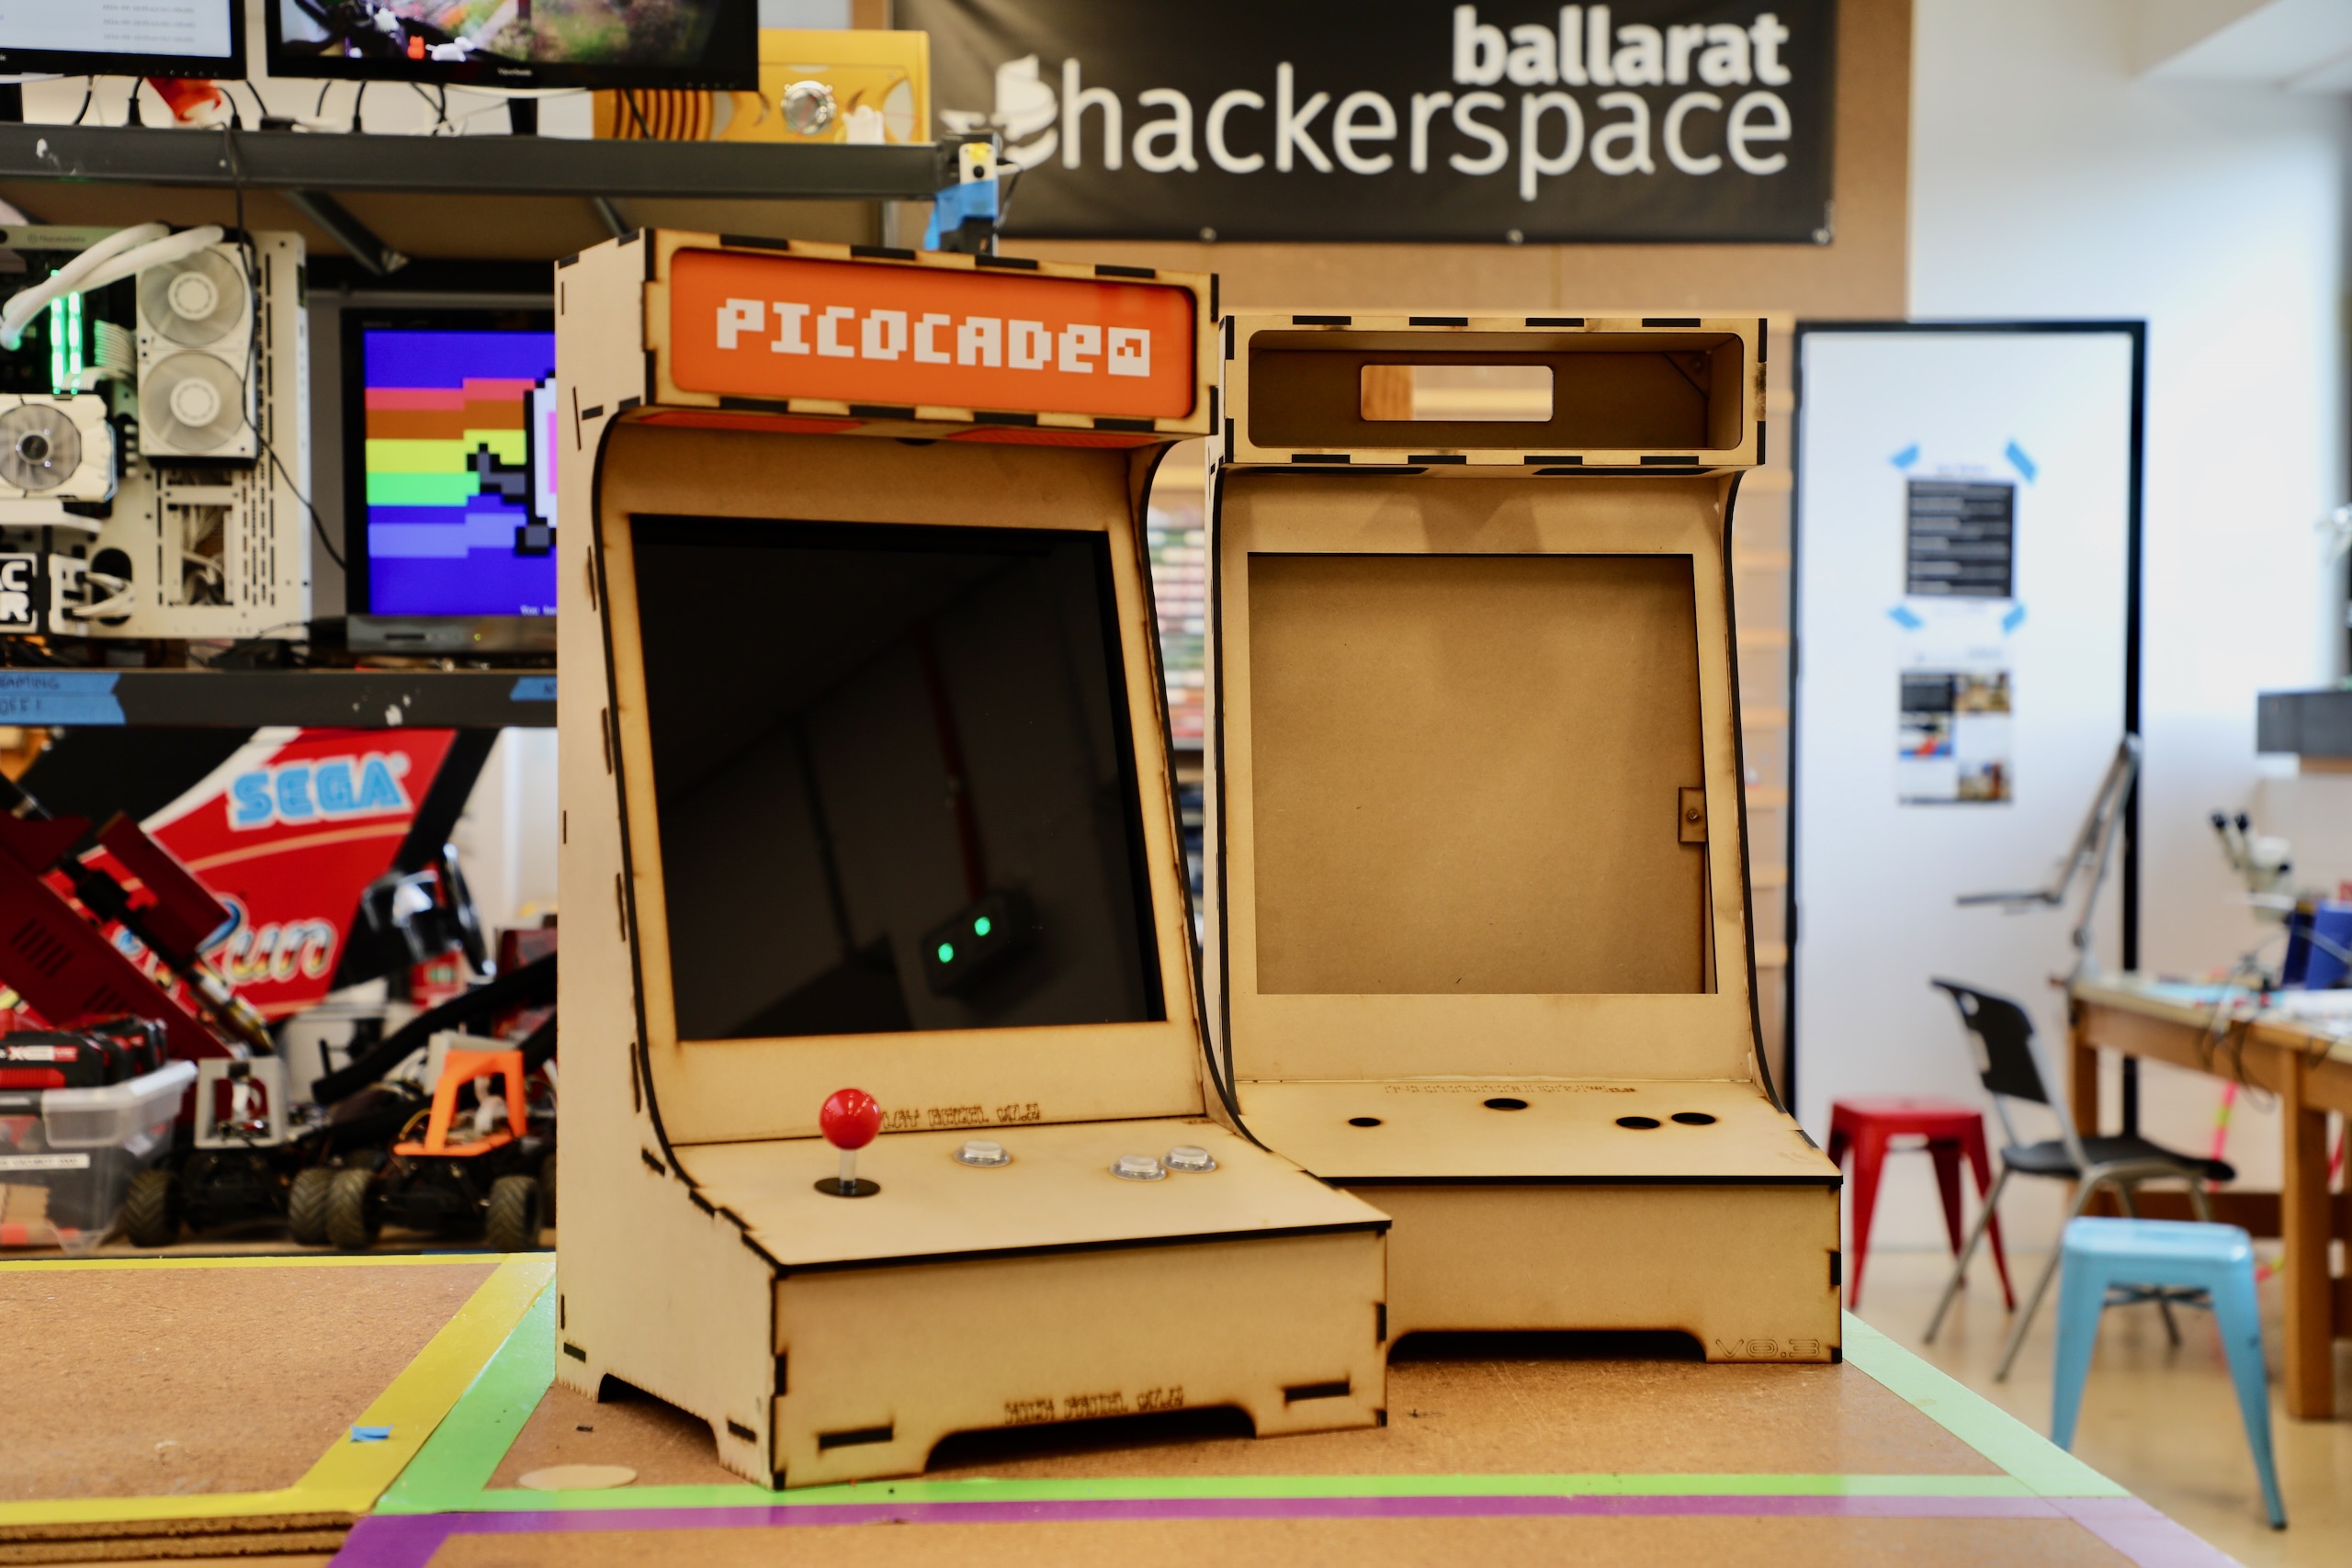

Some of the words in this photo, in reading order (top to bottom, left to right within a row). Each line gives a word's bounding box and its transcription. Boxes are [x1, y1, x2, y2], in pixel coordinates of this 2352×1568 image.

[1453, 5, 1790, 85] ballarat
[1061, 59, 1791, 200] hackerspace
[232, 756, 408, 826] SEGA
